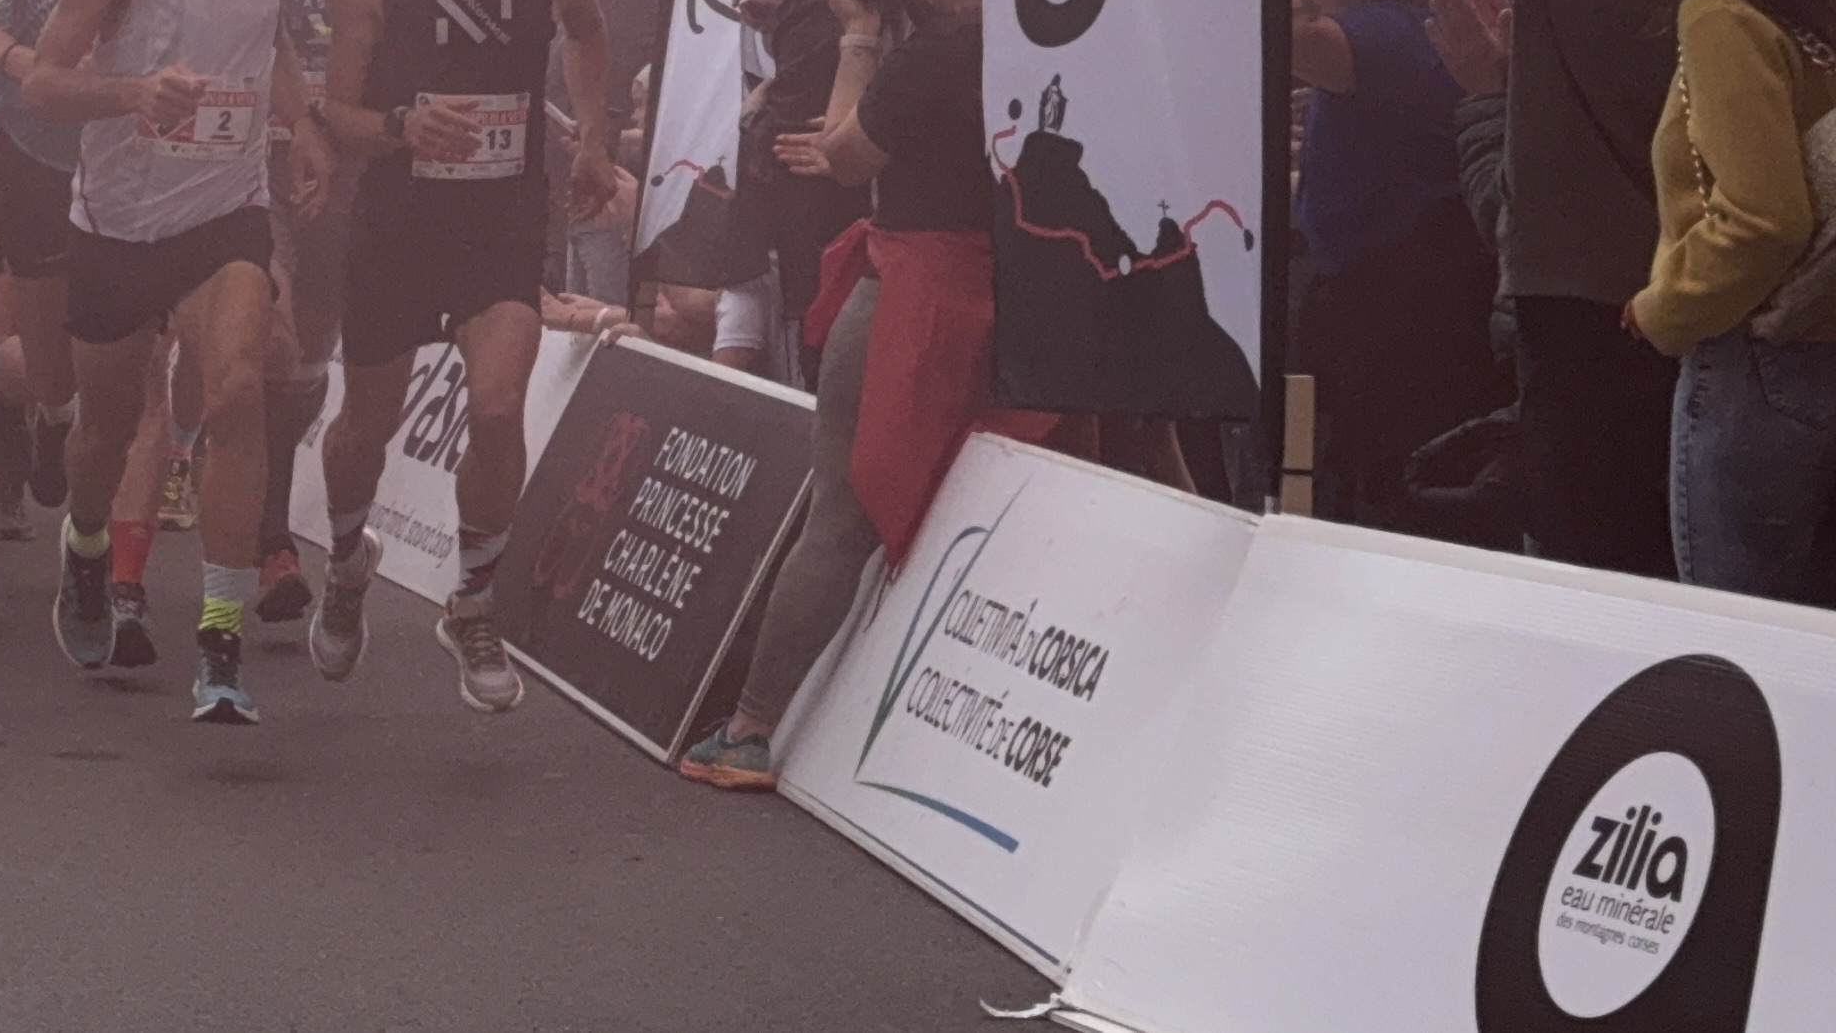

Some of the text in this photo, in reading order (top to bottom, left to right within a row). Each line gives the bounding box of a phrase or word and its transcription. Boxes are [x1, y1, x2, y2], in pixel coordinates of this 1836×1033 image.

[217, 110, 233, 132] 2
[486, 129, 512, 151] 13
[653, 426, 759, 501] FONDATION
[627, 476, 731, 554] PRINCESSE
[604, 528, 703, 609] CHARLÈNE
[577, 578, 673, 662] DE MONACO
[1028, 625, 1110, 702] CORSICA
[1004, 716, 1072, 788] CORSE
[1572, 804, 1689, 904] zilia
[1555, 911, 1574, 930] des
[1627, 934, 1661, 956] corses
[1561, 885, 1676, 935] eau minérale
